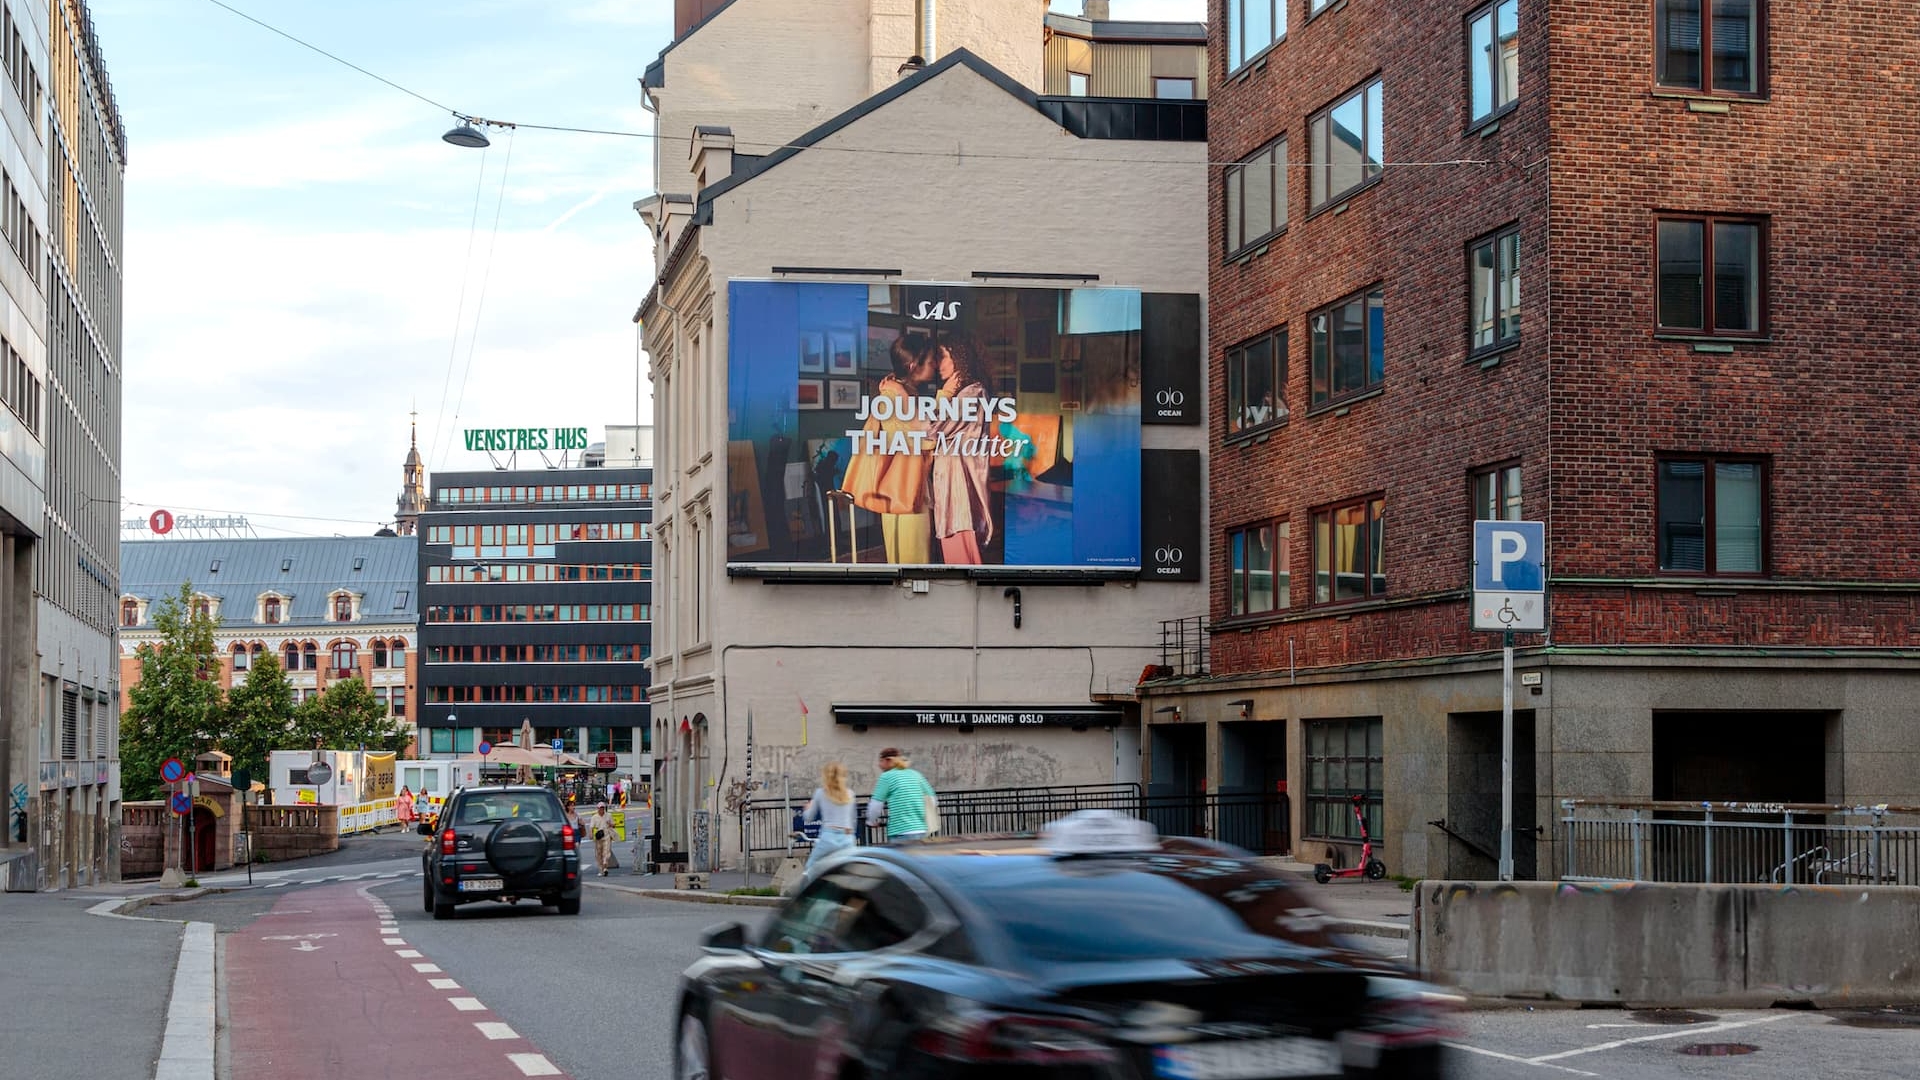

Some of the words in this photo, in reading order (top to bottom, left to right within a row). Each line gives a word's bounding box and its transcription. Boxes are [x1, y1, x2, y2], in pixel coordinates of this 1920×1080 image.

[912, 301, 962, 321] SAS
[855, 395, 1018, 423] JOURNEYS
[464, 428, 548, 451] VENSTRES
[555, 427, 588, 449] HUS
[845, 430, 927, 456] THAT
[932, 431, 1030, 458] Matter
[1492, 530, 1527, 582] P
[916, 713, 935, 724] THE
[940, 713, 966, 724] VILLA
[972, 713, 1014, 724] DANCING
[1019, 713, 1044, 724] OSLO
[554, 741, 561, 749] P
